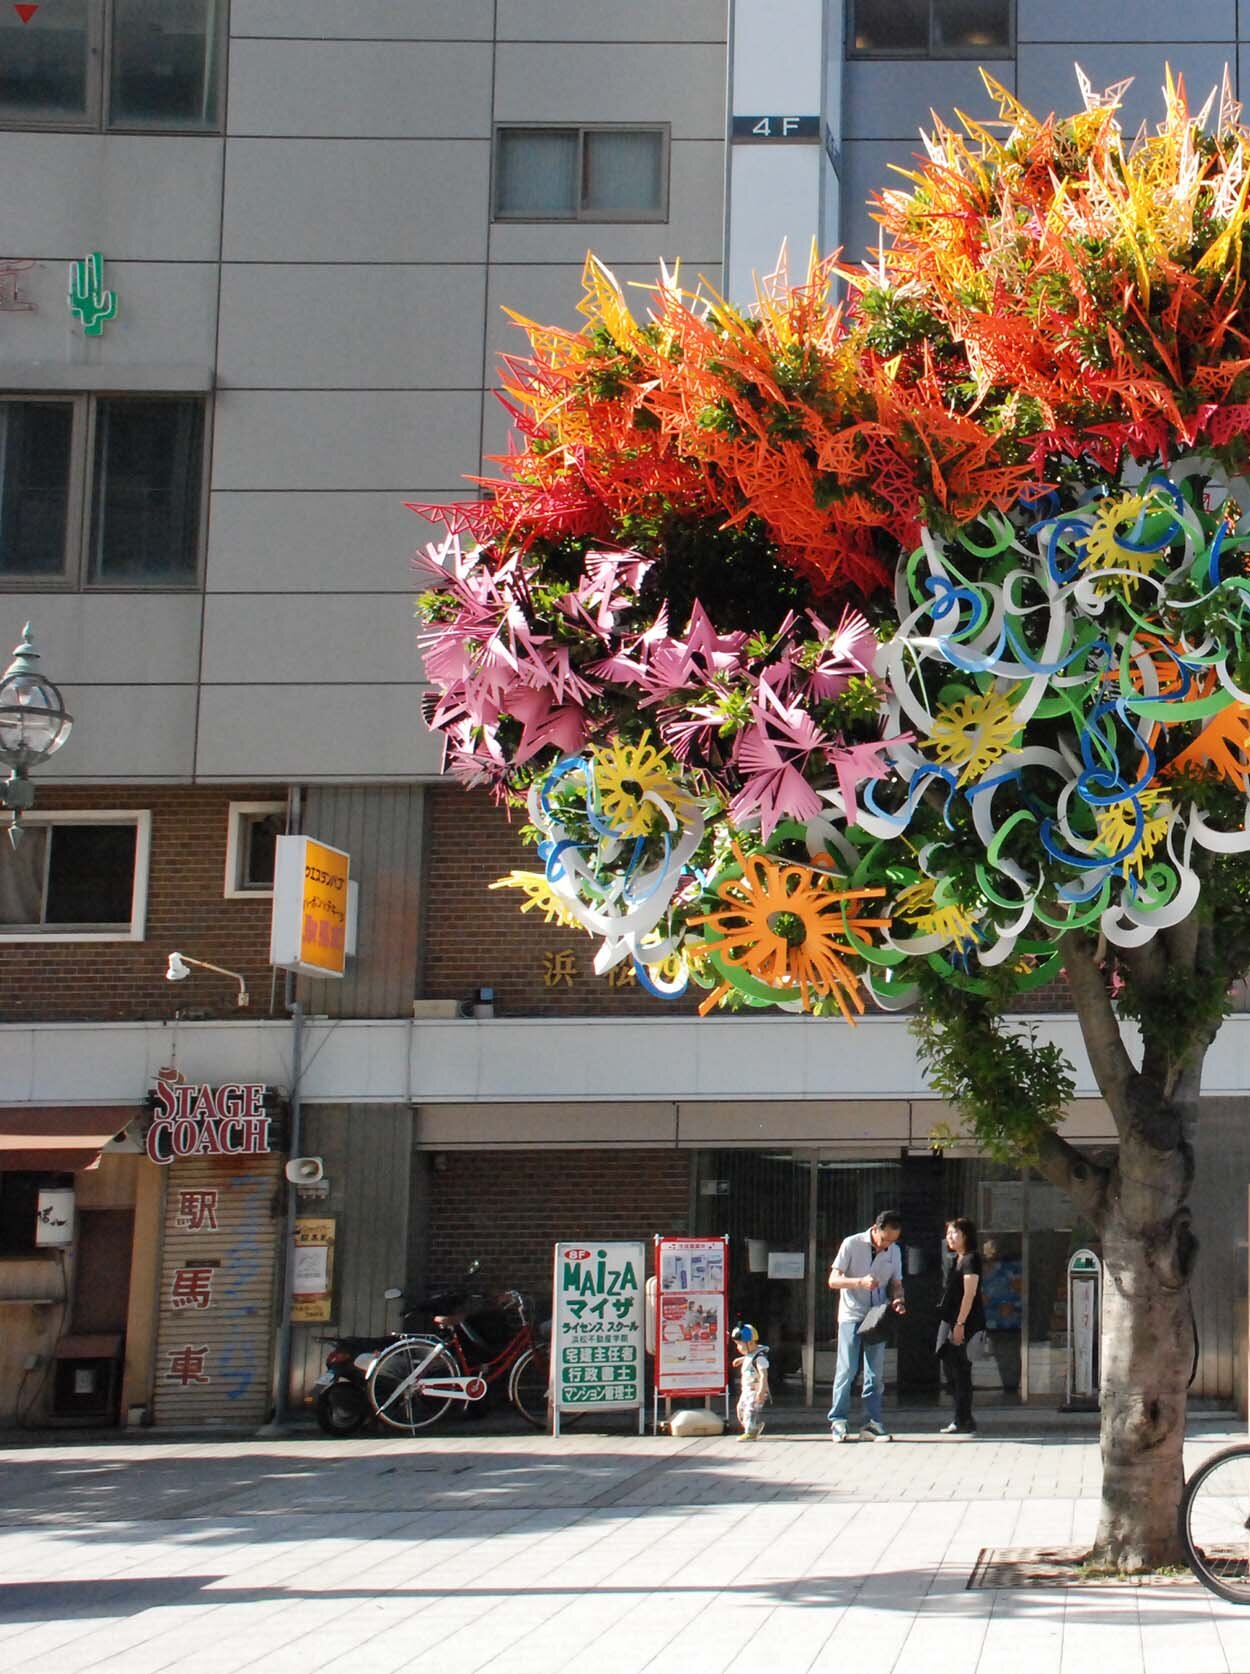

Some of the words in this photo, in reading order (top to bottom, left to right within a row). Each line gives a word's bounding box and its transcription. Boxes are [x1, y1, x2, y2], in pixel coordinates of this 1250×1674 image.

[154, 1080, 266, 1120] STAGE
[147, 1118, 271, 1165] COACH
[165, 1189, 218, 1387] 駅馬車
[566, 1296, 634, 1319] マイザ
[562, 1321, 604, 1334] ライセンス
[607, 1321, 638, 1333] スクール
[568, 1366, 631, 1382] 行政書士
[564, 1385, 634, 1401] マンション管理士
